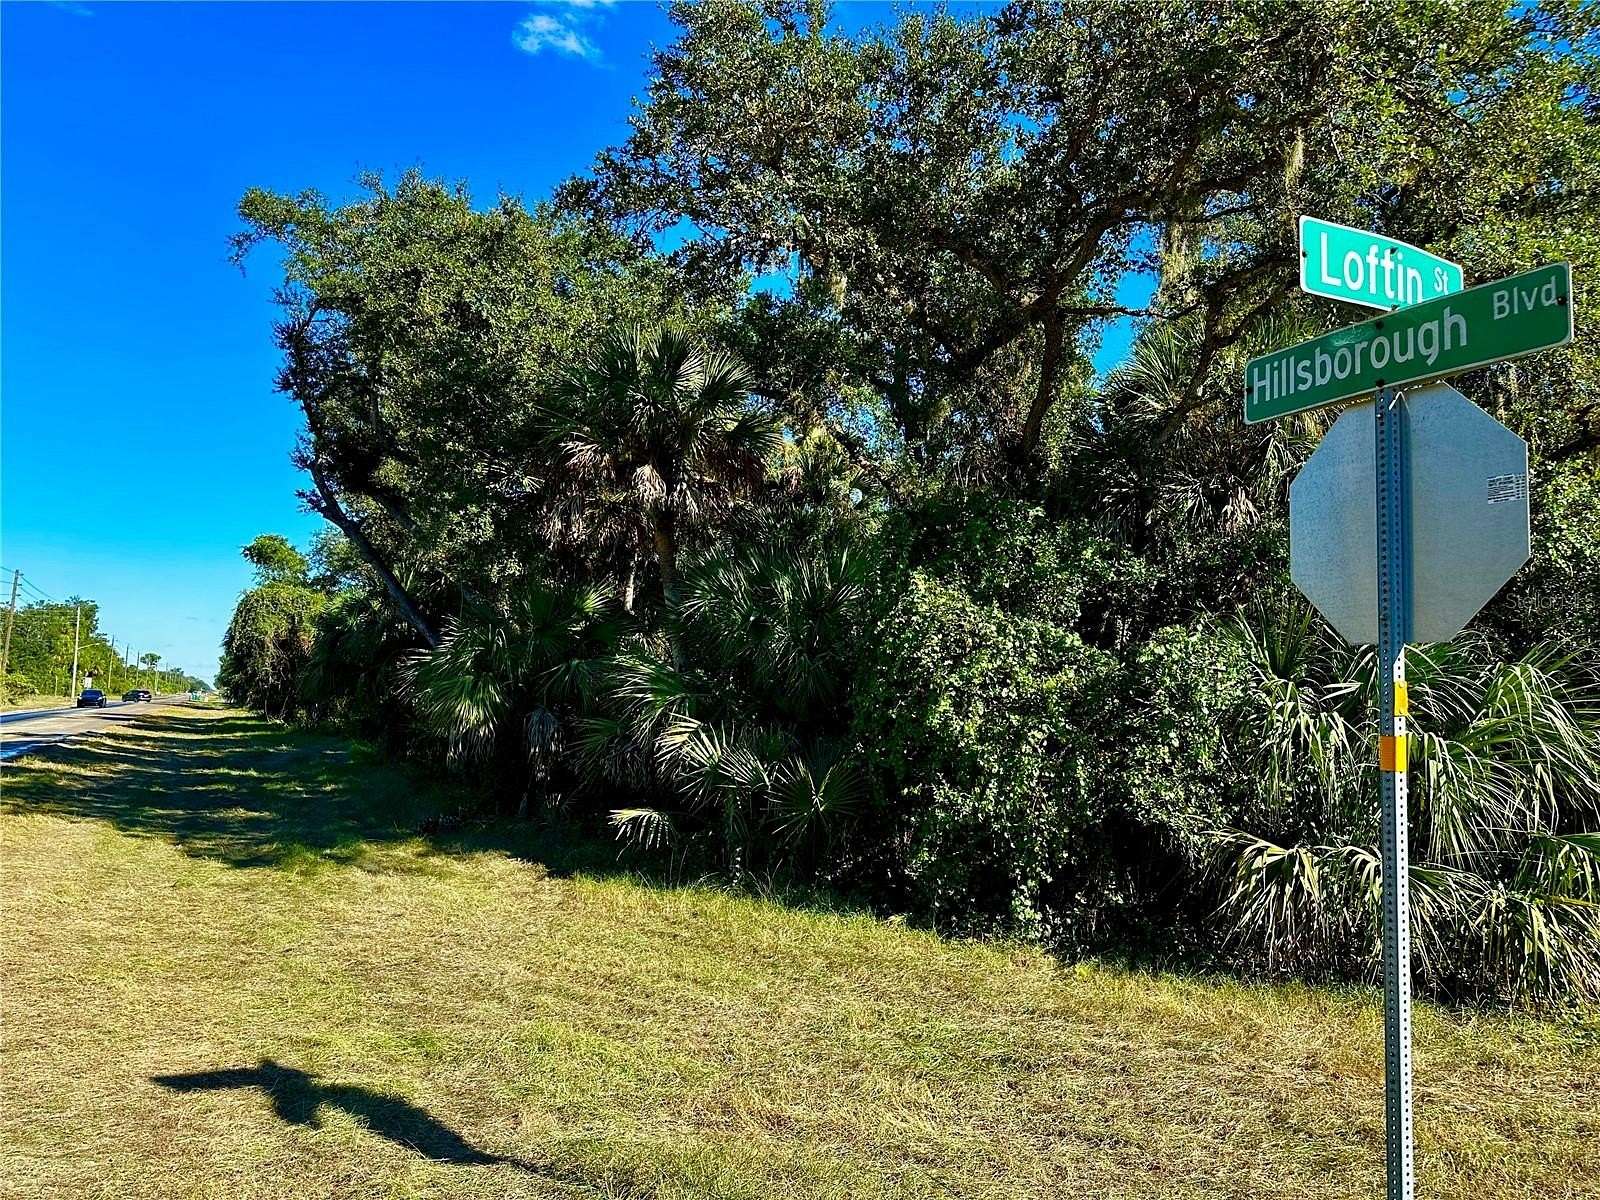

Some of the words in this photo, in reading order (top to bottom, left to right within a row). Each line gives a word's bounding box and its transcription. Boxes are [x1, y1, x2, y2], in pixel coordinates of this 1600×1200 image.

[1320, 231, 1423, 305] Loftin
[1433, 266, 1449, 295] St
[1252, 306, 1468, 405] Hillsborough
[1492, 275, 1558, 320] Blvd
